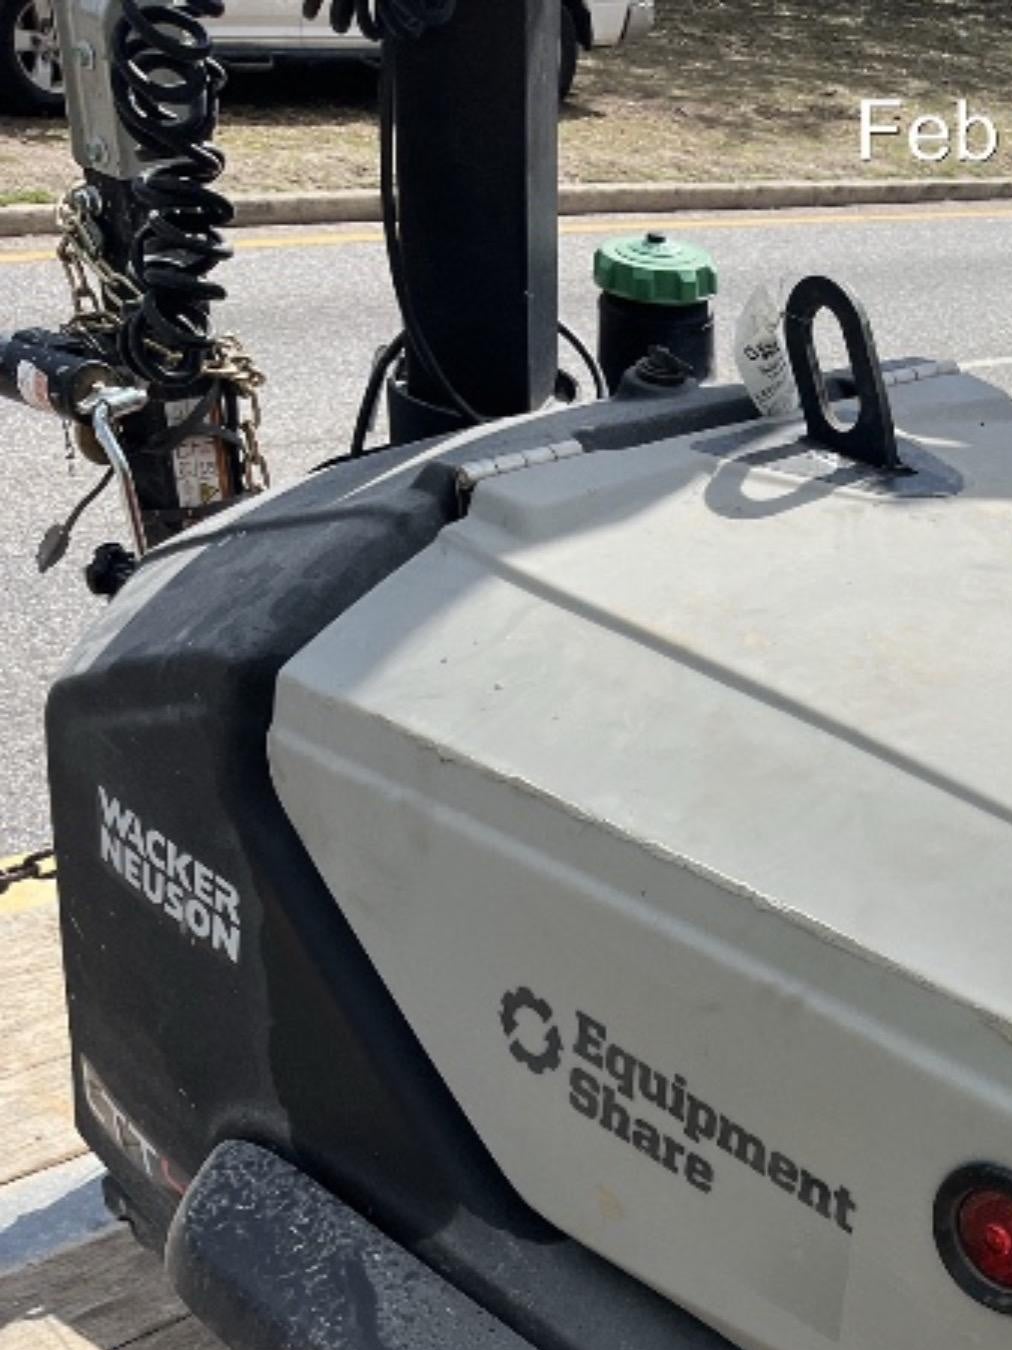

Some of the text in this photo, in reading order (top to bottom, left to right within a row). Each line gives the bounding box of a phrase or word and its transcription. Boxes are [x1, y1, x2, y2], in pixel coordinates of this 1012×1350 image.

[97, 783, 242, 927] WACKER
[99, 822, 242, 966] NEUSON
[567, 1066, 716, 1195] Share
[572, 1009, 858, 1234] Equipment
